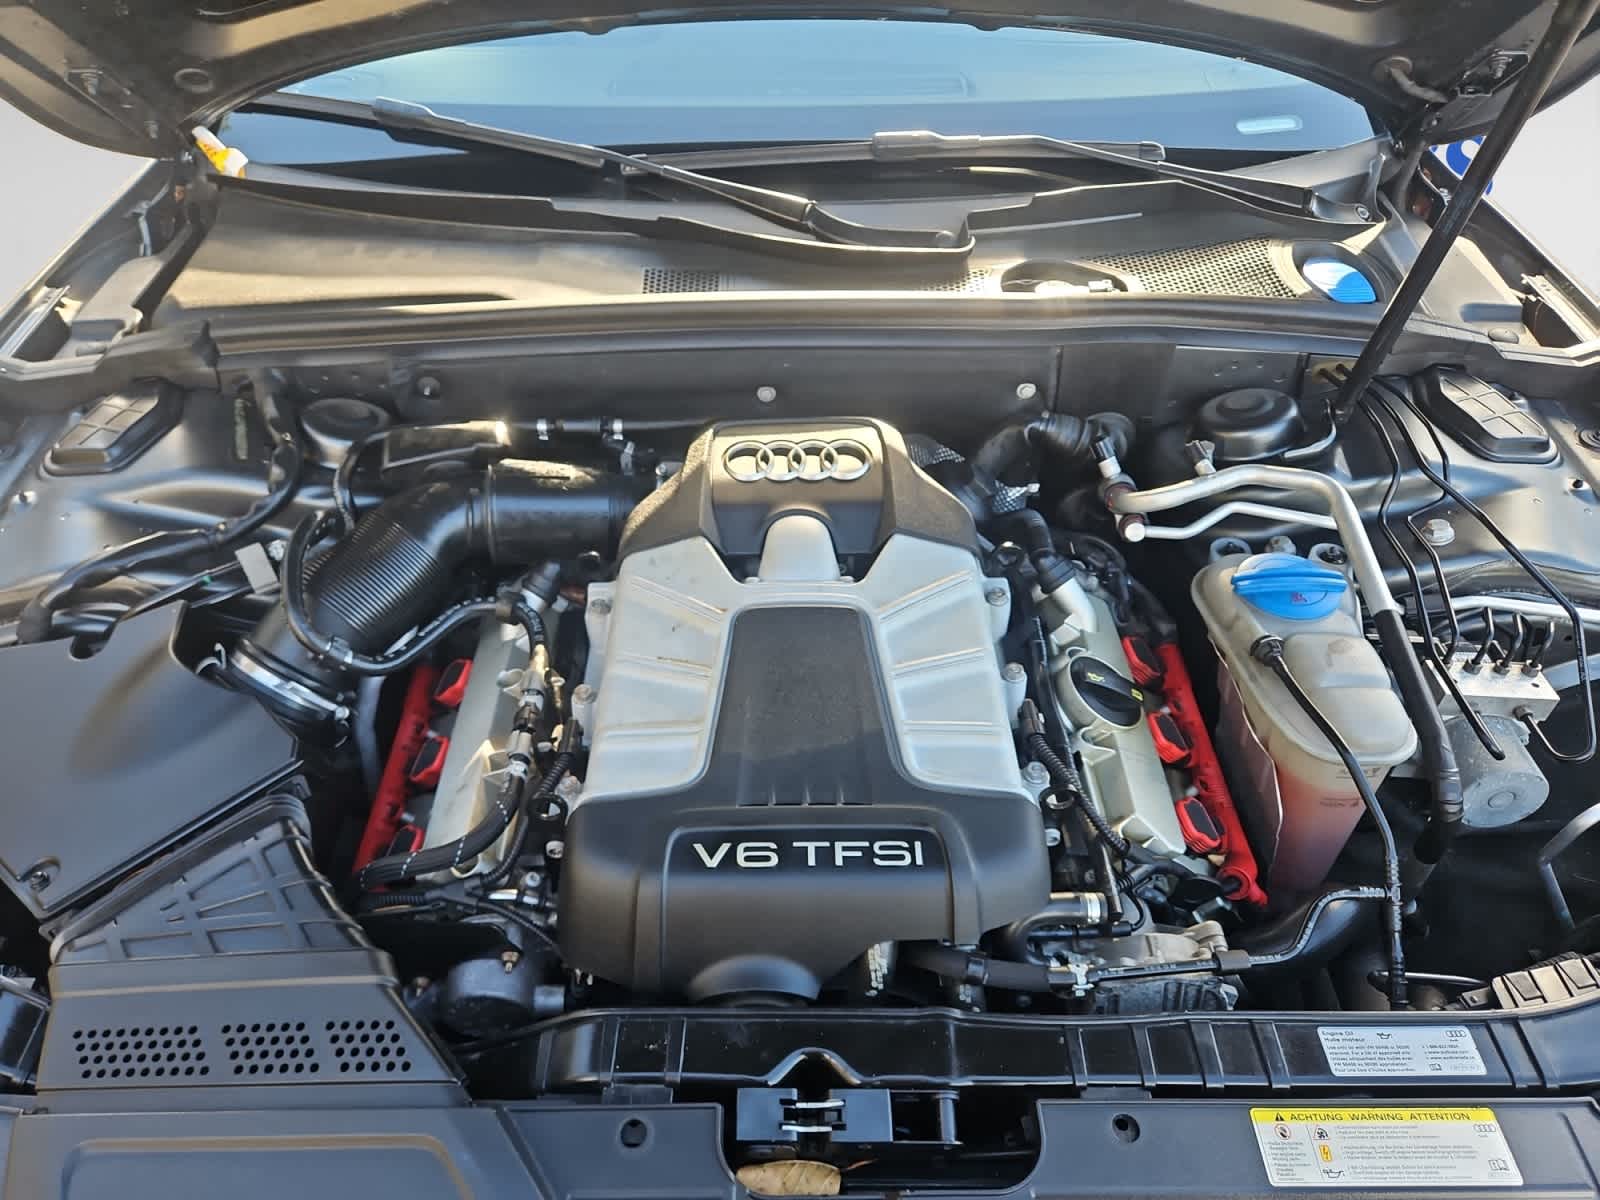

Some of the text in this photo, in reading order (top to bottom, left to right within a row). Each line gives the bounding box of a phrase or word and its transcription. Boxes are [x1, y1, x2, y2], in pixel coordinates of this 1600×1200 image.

[692, 840, 924, 869] V6 TFSI
[1290, 1112, 1471, 1121] ACHTUNG WARNING ATTENTION
